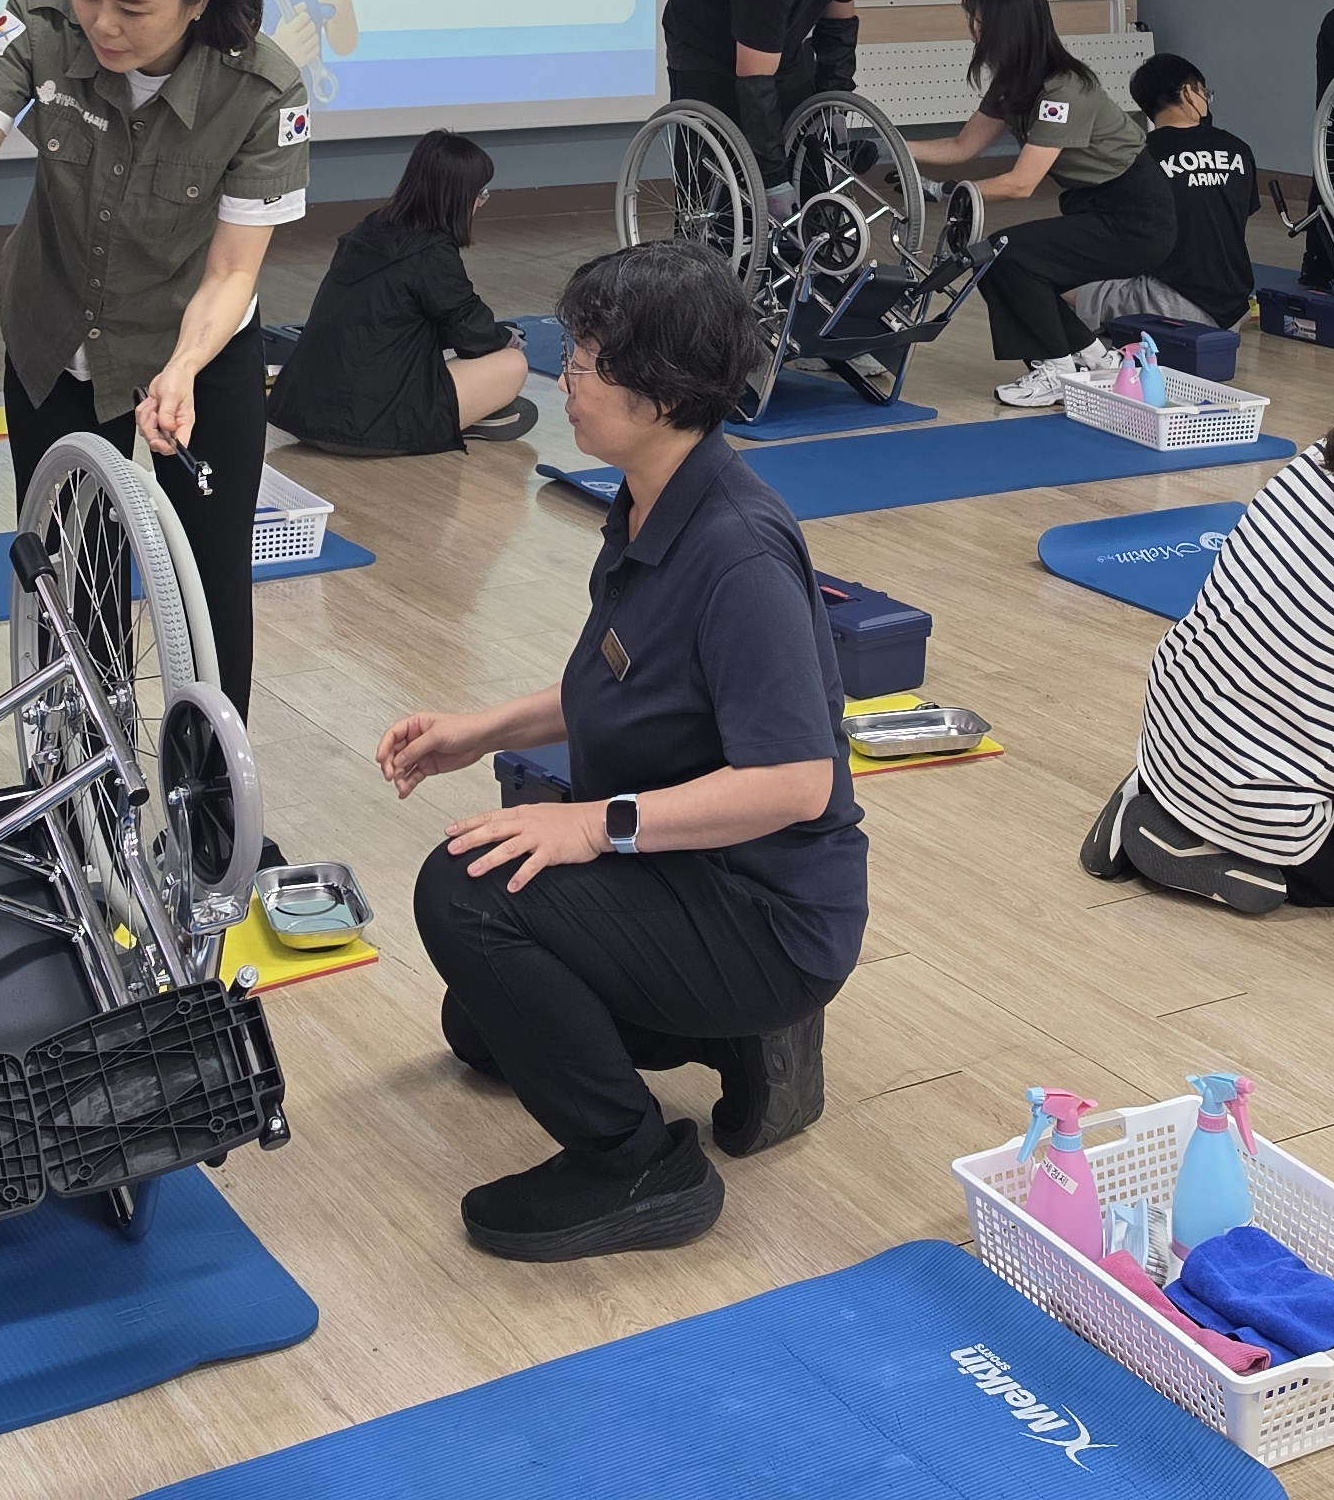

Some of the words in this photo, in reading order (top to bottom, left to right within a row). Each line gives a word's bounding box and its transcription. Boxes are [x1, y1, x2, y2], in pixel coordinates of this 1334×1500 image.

[1159, 150, 1245, 178] KOREA
[1188, 172, 1230, 187] ARMY
[1115, 542, 1201, 564] Melkin
[635, 1202, 651, 1213] MAX
[973, 1342, 1012, 1372] SPORTS
[950, 1347, 1070, 1434] Melkin
